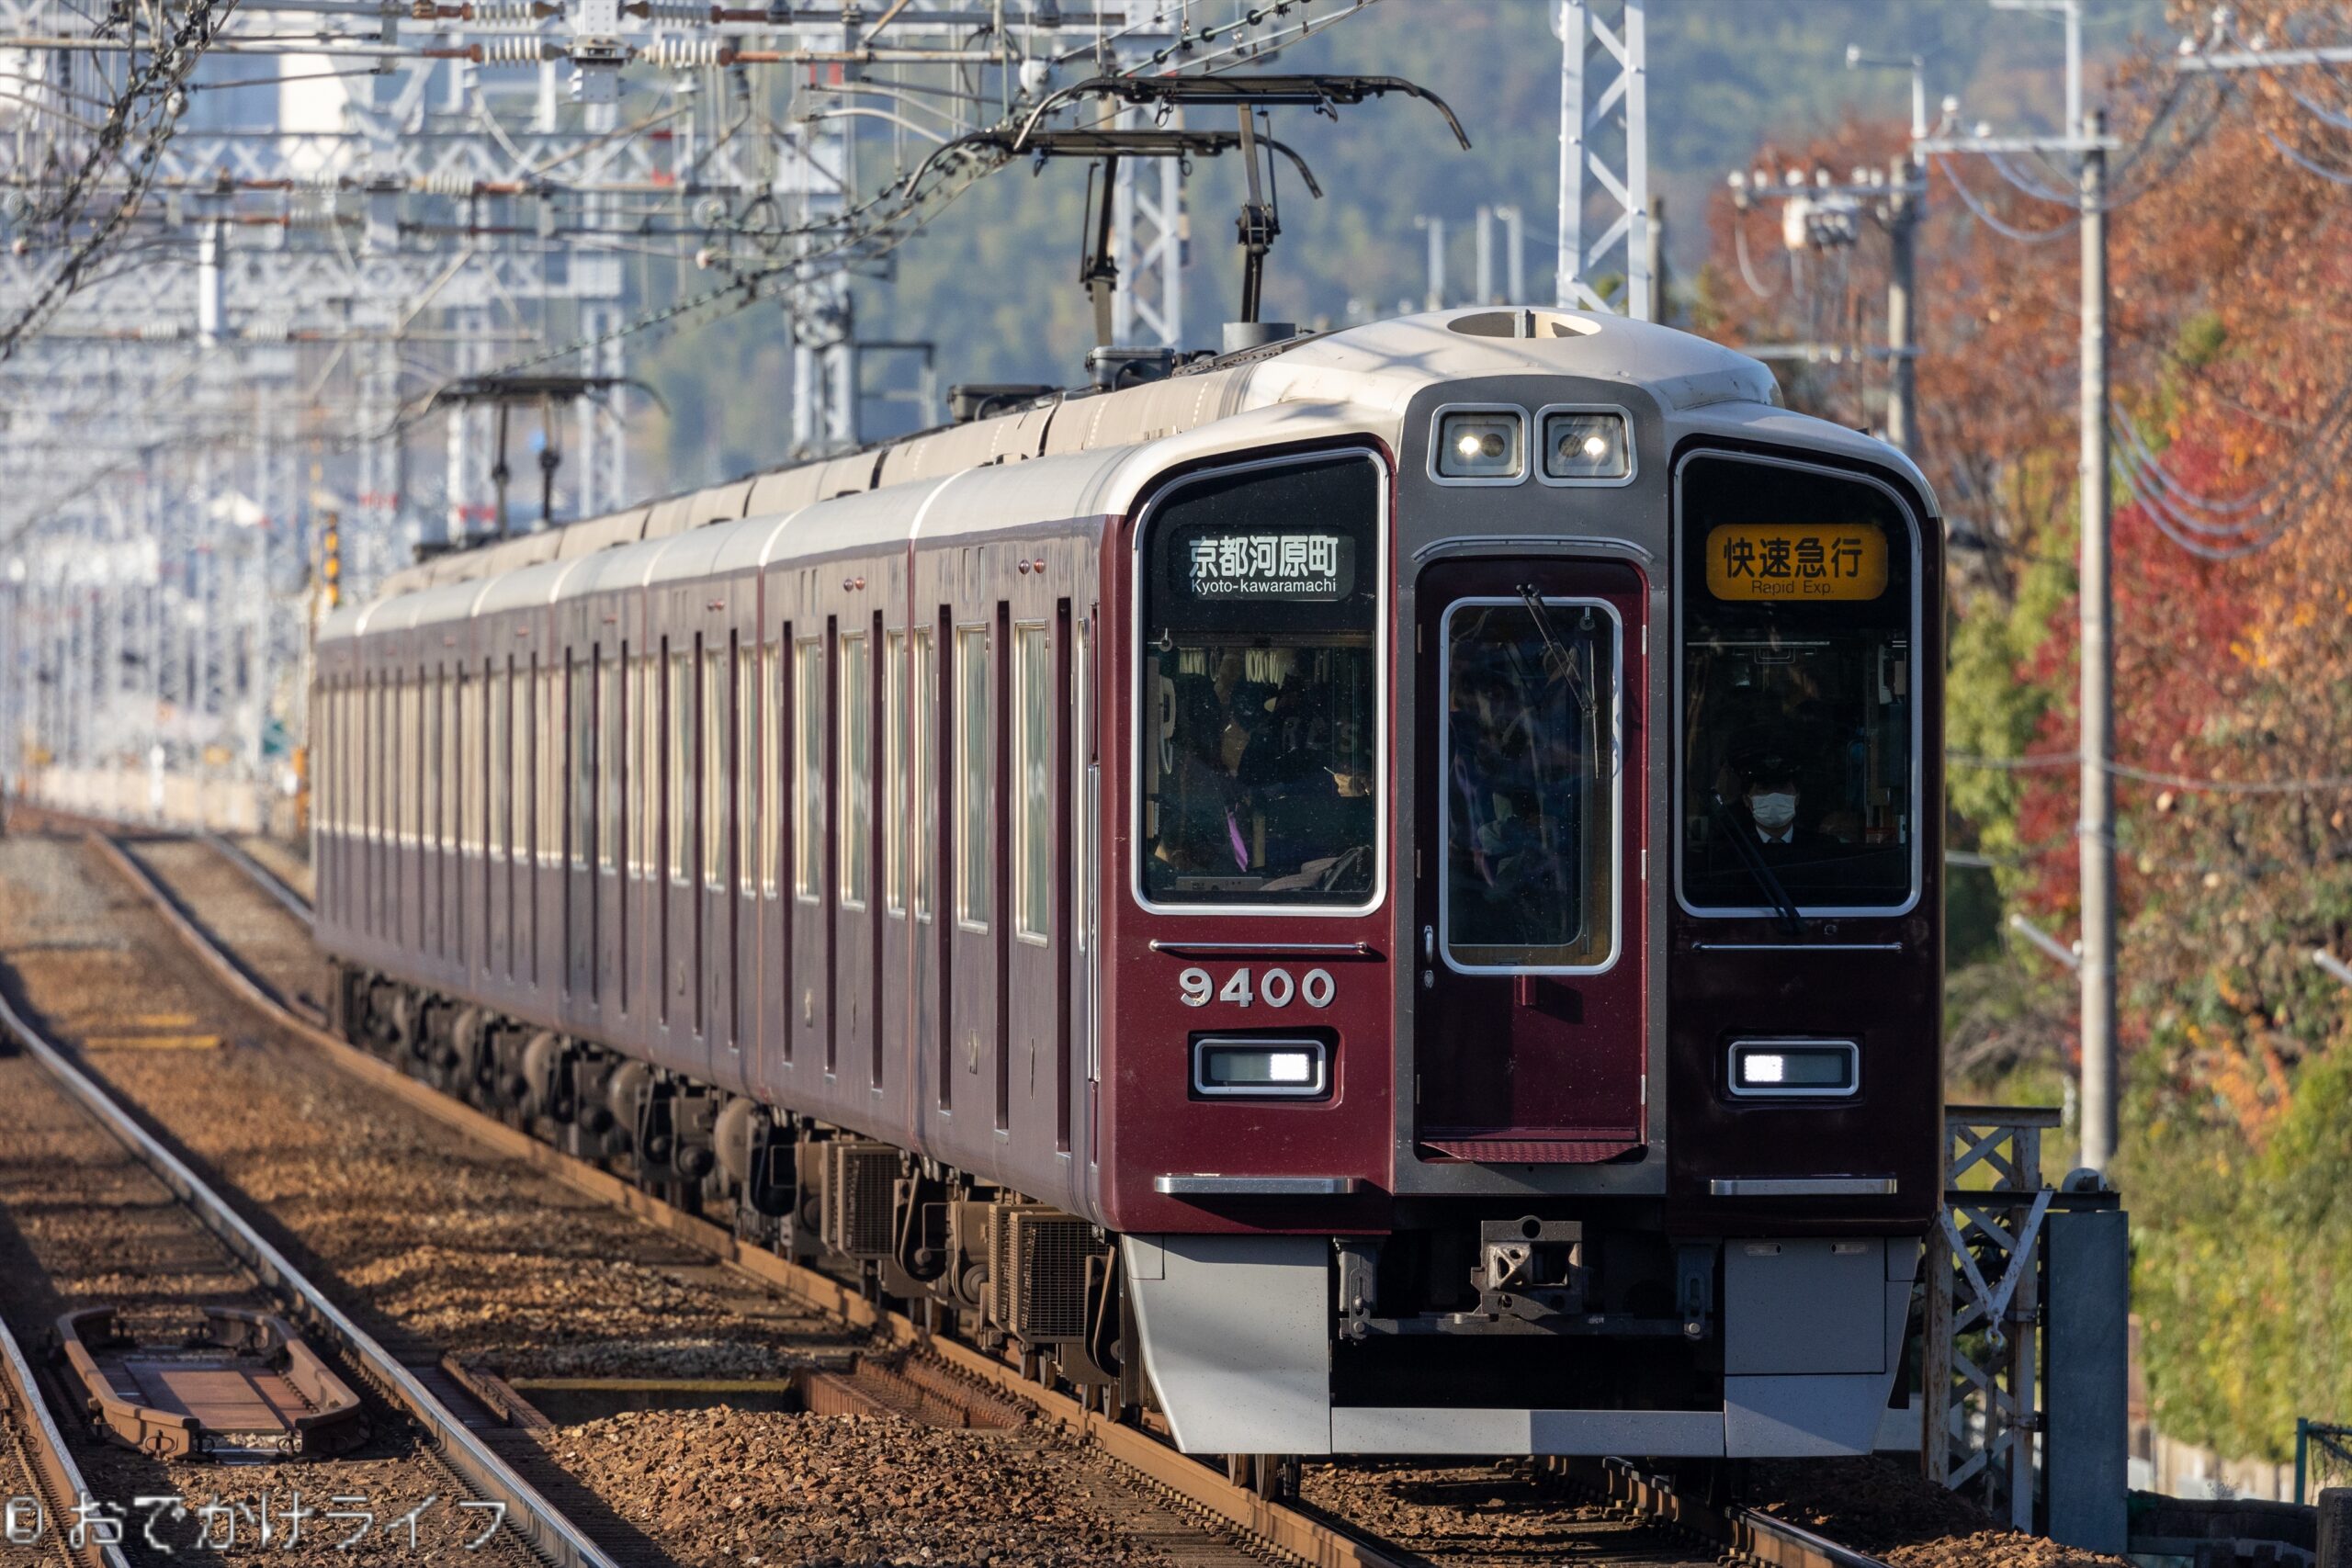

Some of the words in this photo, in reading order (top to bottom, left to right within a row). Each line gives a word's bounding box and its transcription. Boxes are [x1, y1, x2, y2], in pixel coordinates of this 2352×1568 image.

[1189, 535, 1339, 578] 京都河原町
[1723, 536, 1863, 579] 快速急行
[1192, 578, 1336, 595] Kyoto-kawaramachi
[1751, 580, 1794, 596] Rapid
[1803, 580, 1835, 595] Exp.
[1179, 967, 1336, 1009] 9400
